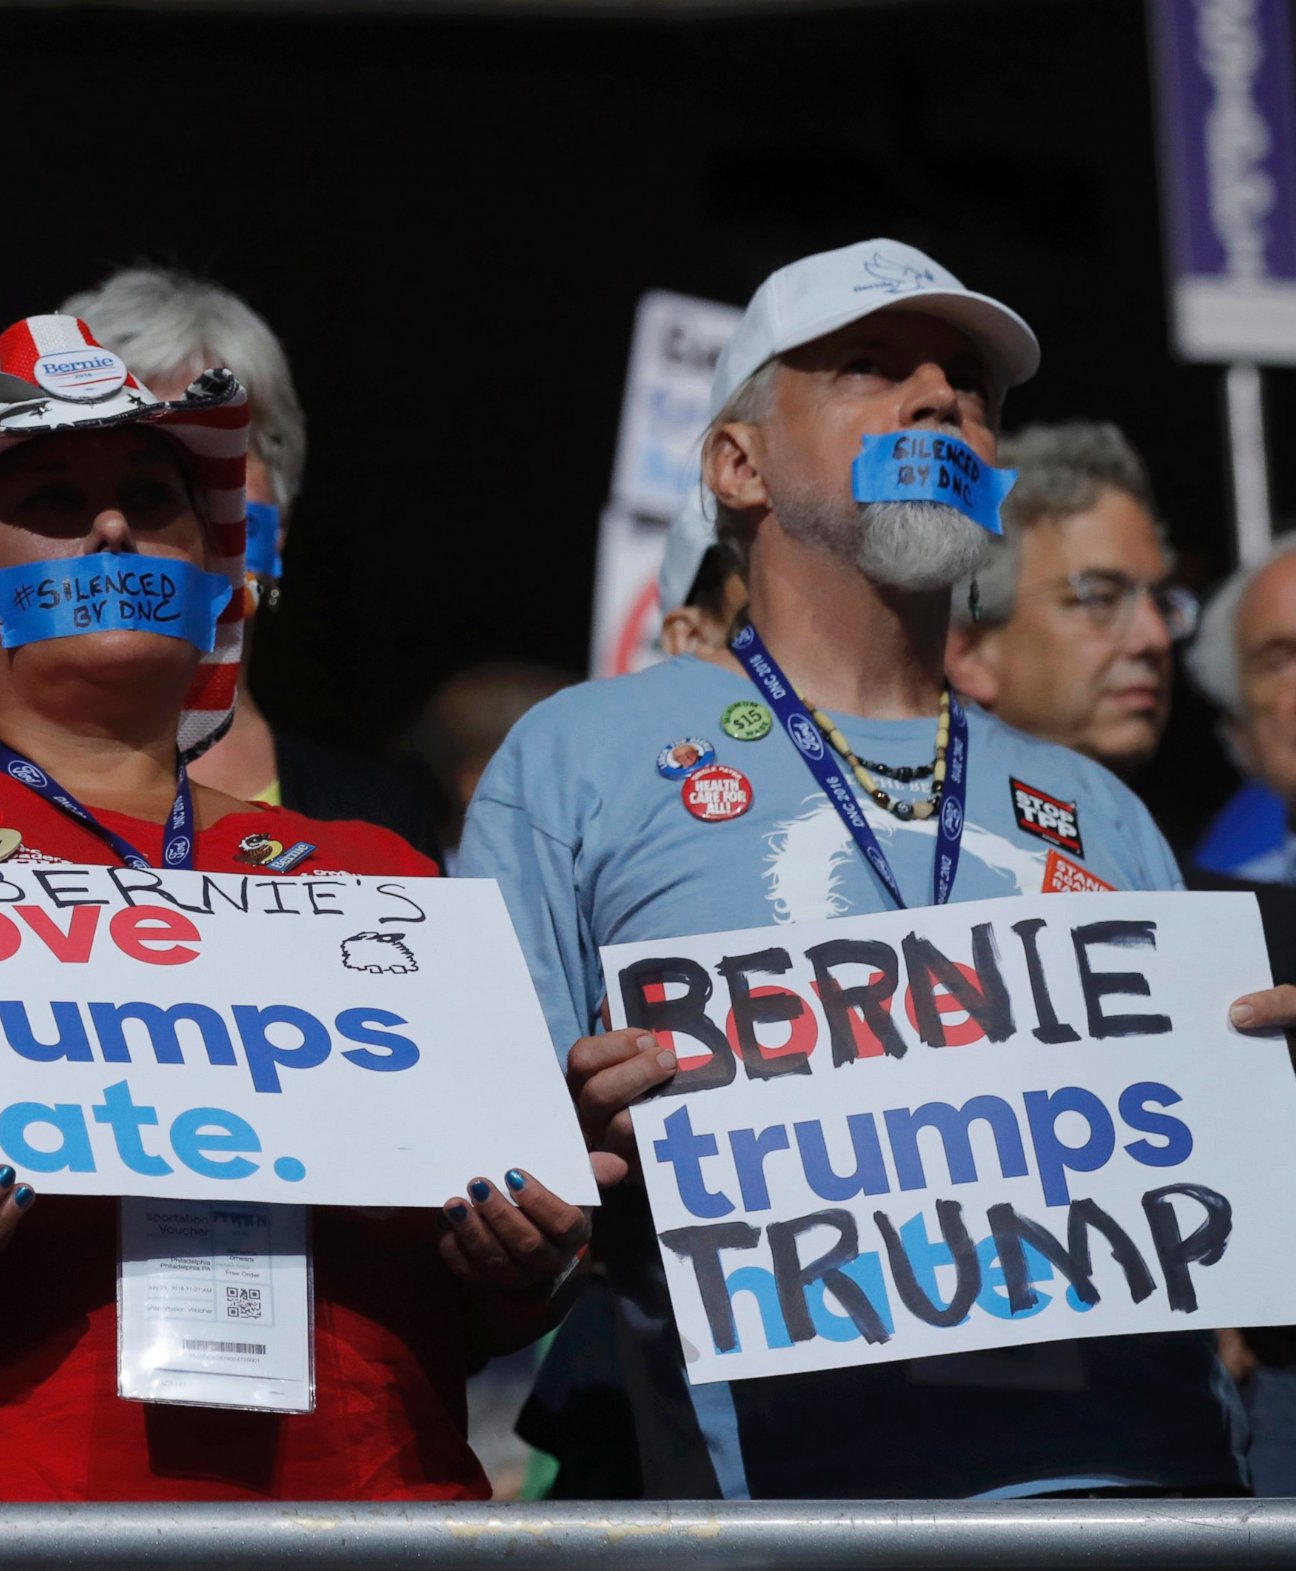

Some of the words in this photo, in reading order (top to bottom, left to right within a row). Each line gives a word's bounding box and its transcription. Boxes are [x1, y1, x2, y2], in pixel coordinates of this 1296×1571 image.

[42, 357, 114, 374] Bernie
[892, 436, 980, 482] SILENCED
[897, 464, 930, 487] BY
[937, 465, 974, 508] DNC
[73, 600, 107, 627] BY
[119, 600, 181, 622] DNC
[764, 676, 786, 701] DNC
[733, 709, 762, 730] $15
[689, 791, 721, 804] CARE
[724, 790, 747, 803] FOR
[695, 779, 740, 792] HEALTH
[707, 803, 732, 815] ALL!
[1015, 789, 1075, 823] STOP
[1017, 802, 1078, 837] TPP
[272, 843, 309, 870] Bernie
[618, 919, 1173, 1097] BERNIE
[653, 1081, 1194, 1219] trumps
[159, 1224, 210, 1238] Voucher
[659, 1182, 1233, 1352] TRUMP
